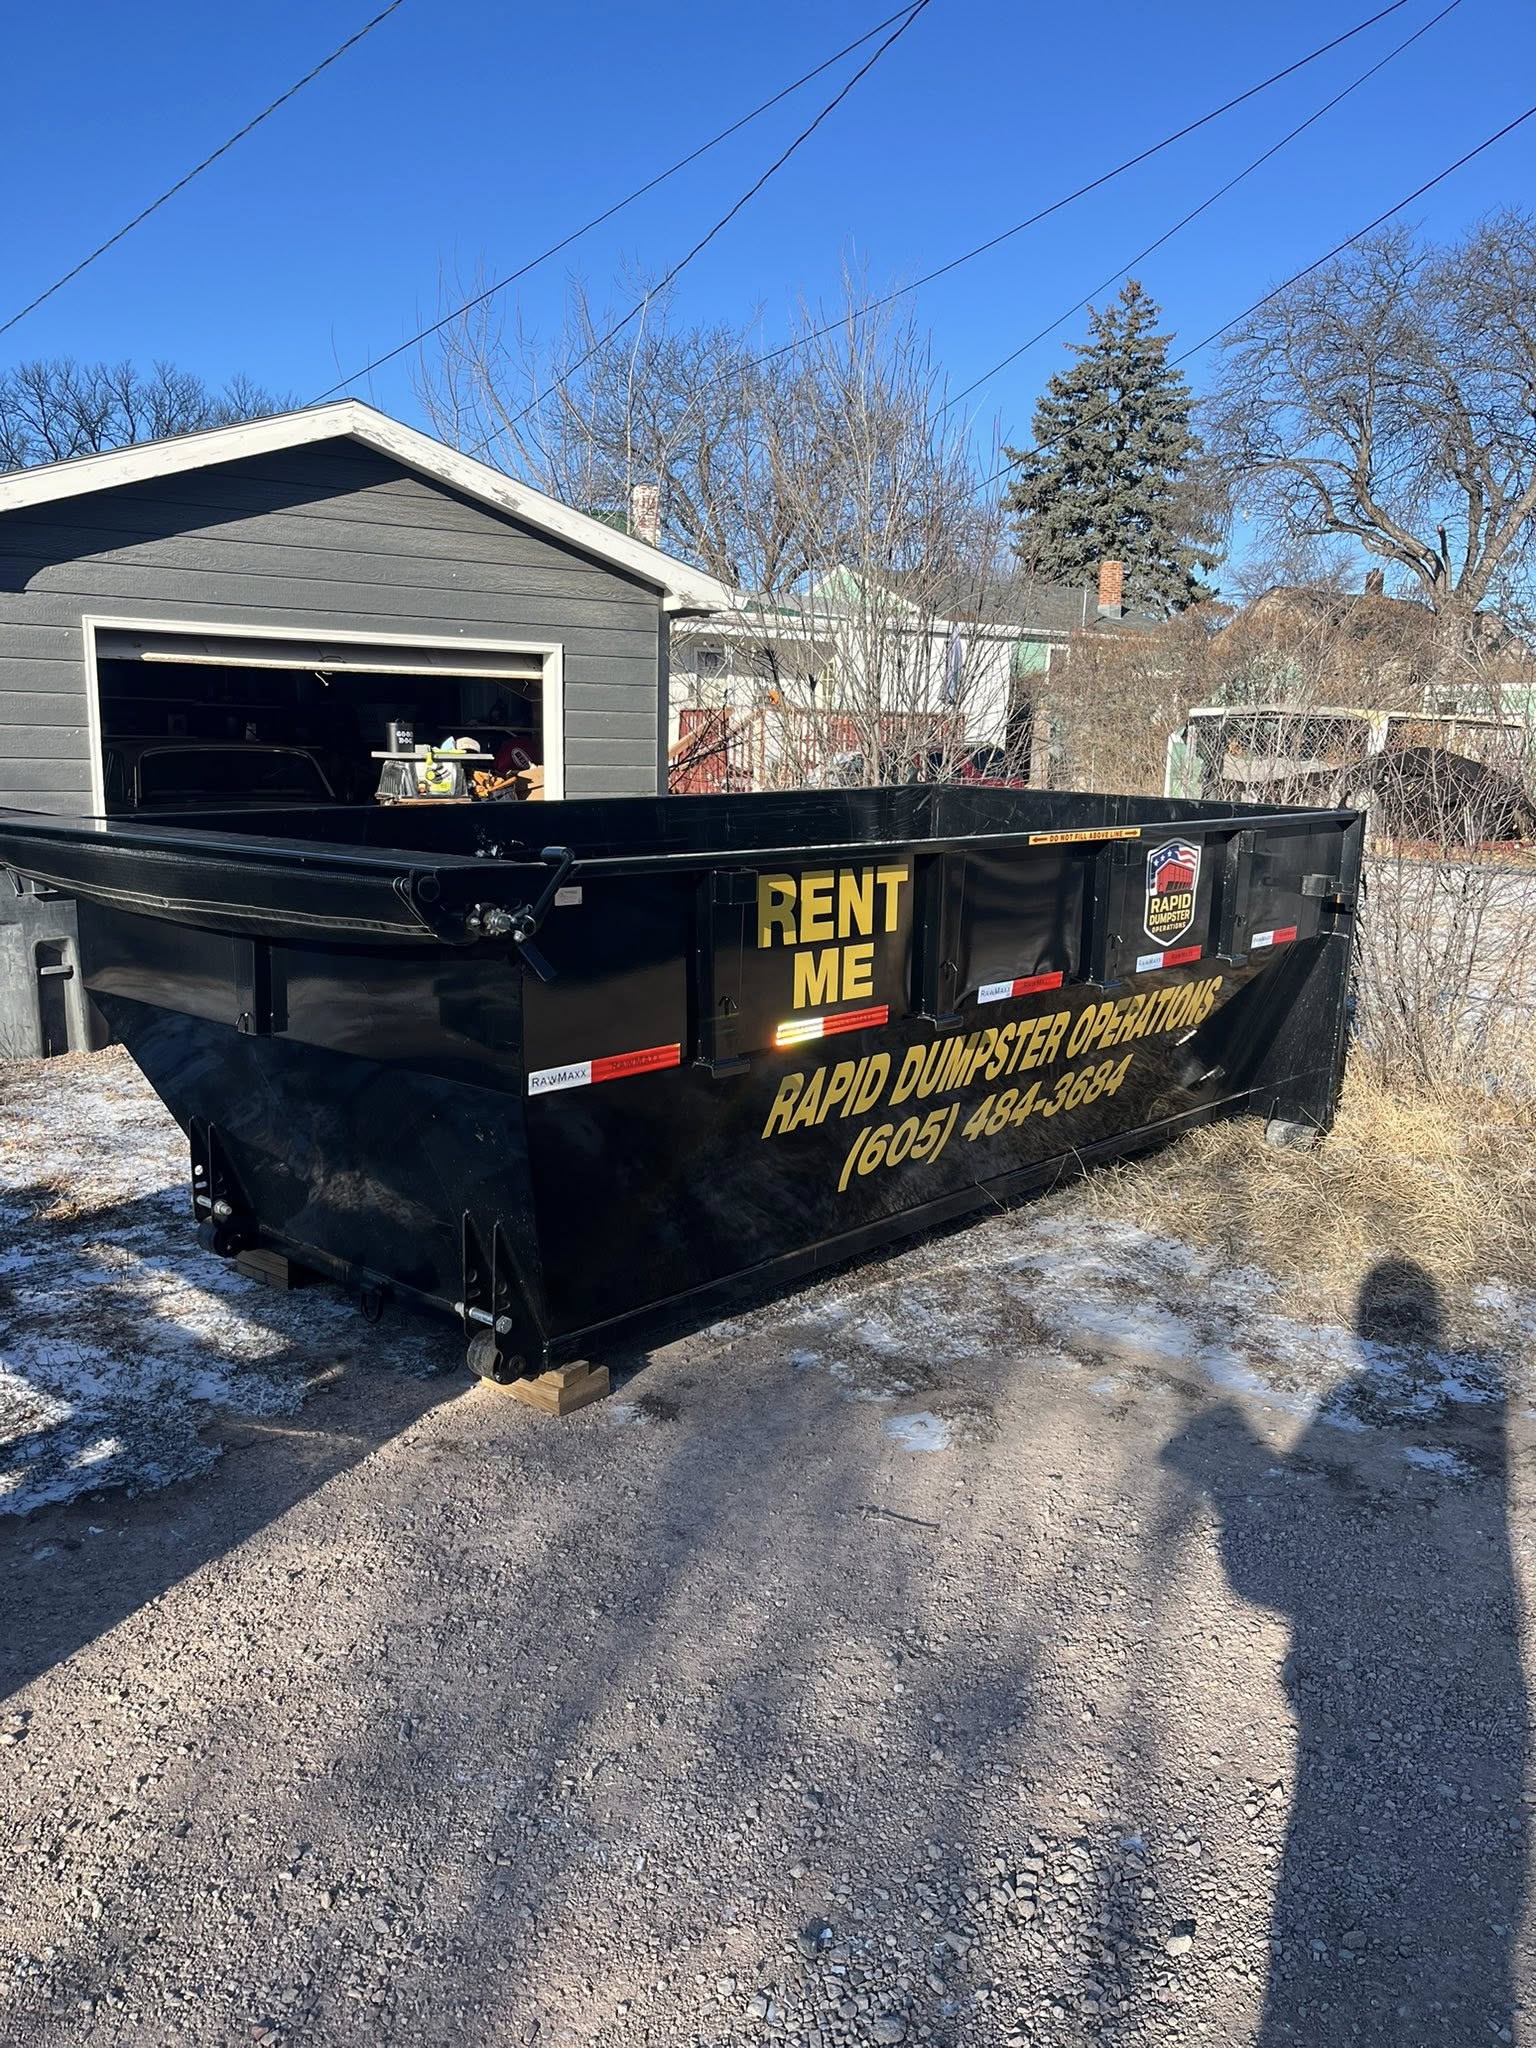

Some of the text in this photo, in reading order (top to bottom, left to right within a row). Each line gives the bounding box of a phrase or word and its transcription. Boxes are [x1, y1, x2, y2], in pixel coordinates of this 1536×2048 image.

[1110, 830, 1123, 838] LINE
[757, 864, 909, 949] RENT
[1149, 909, 1191, 926] DUMPSTER
[1150, 893, 1192, 914] RAPID
[1151, 921, 1187, 934] OPERATIONS
[793, 943, 874, 1009] ME
[761, 975, 1224, 1140] RAPID DUMPSTER OPERATIONS
[837, 1053, 1134, 1193] (605) 484-3684
